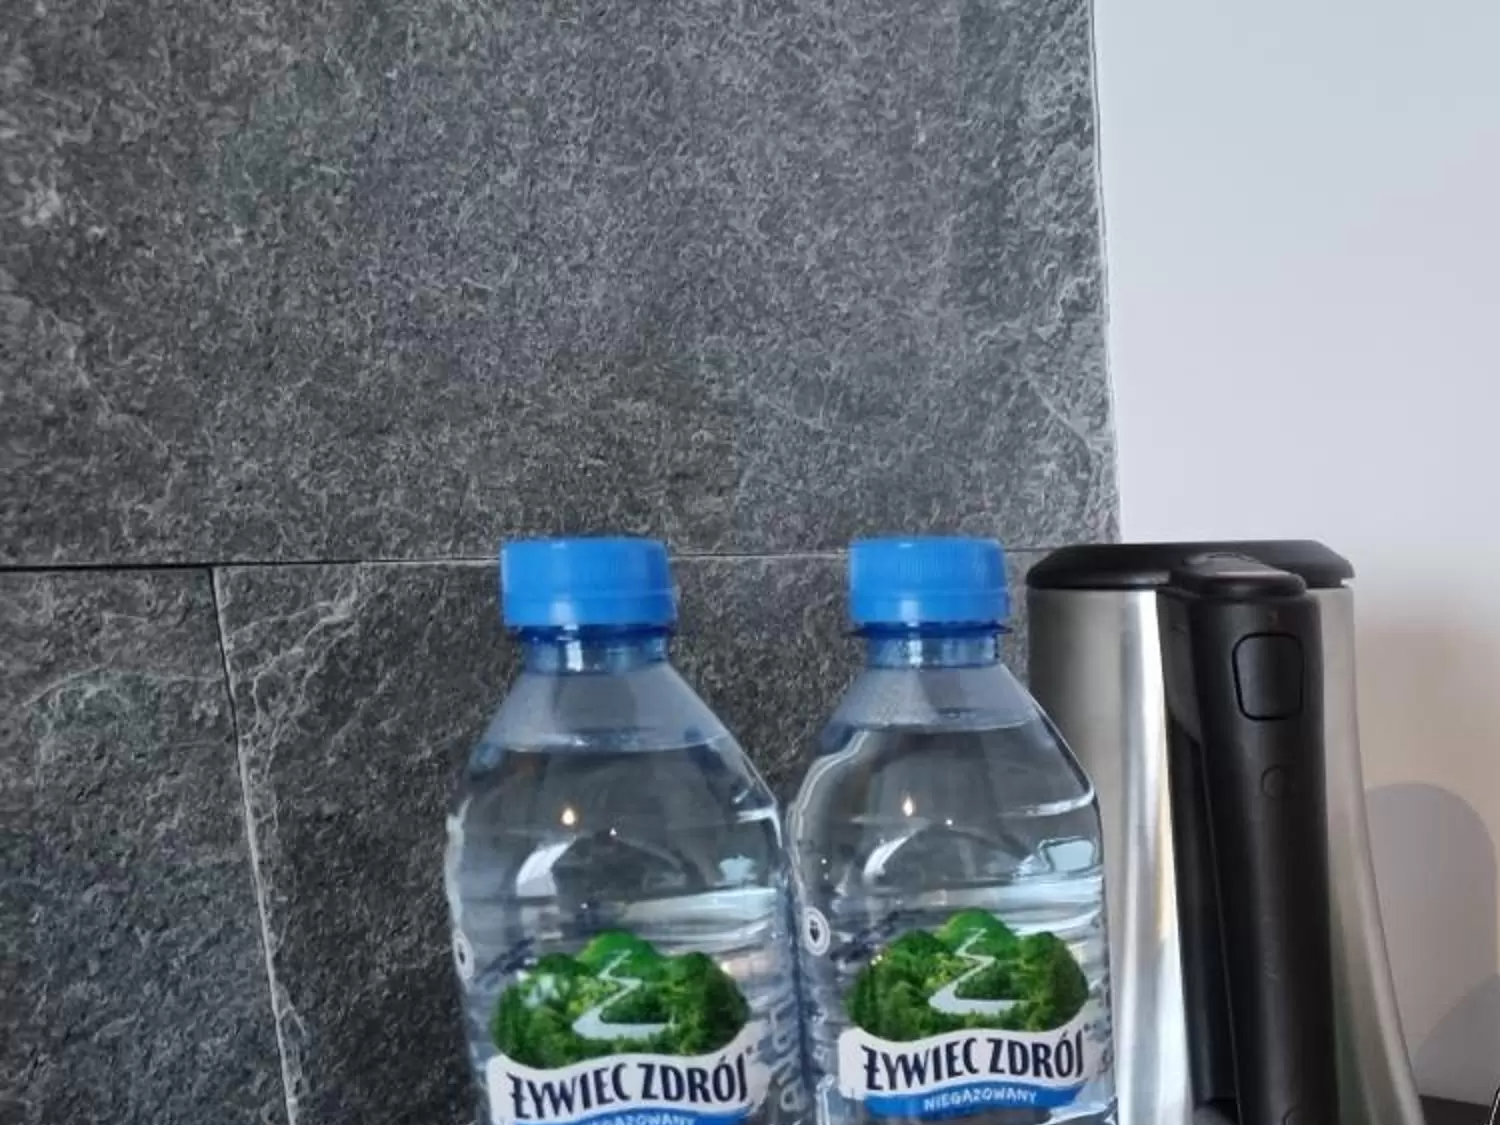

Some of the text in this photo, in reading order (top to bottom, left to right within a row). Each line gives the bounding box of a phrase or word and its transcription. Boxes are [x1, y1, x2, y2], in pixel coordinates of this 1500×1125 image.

[637, 1053, 748, 1103] ZDRÓJ
[985, 1029, 1084, 1079] ZDRÓJ
[923, 1087, 1038, 1111] NIEGAZOWANY
